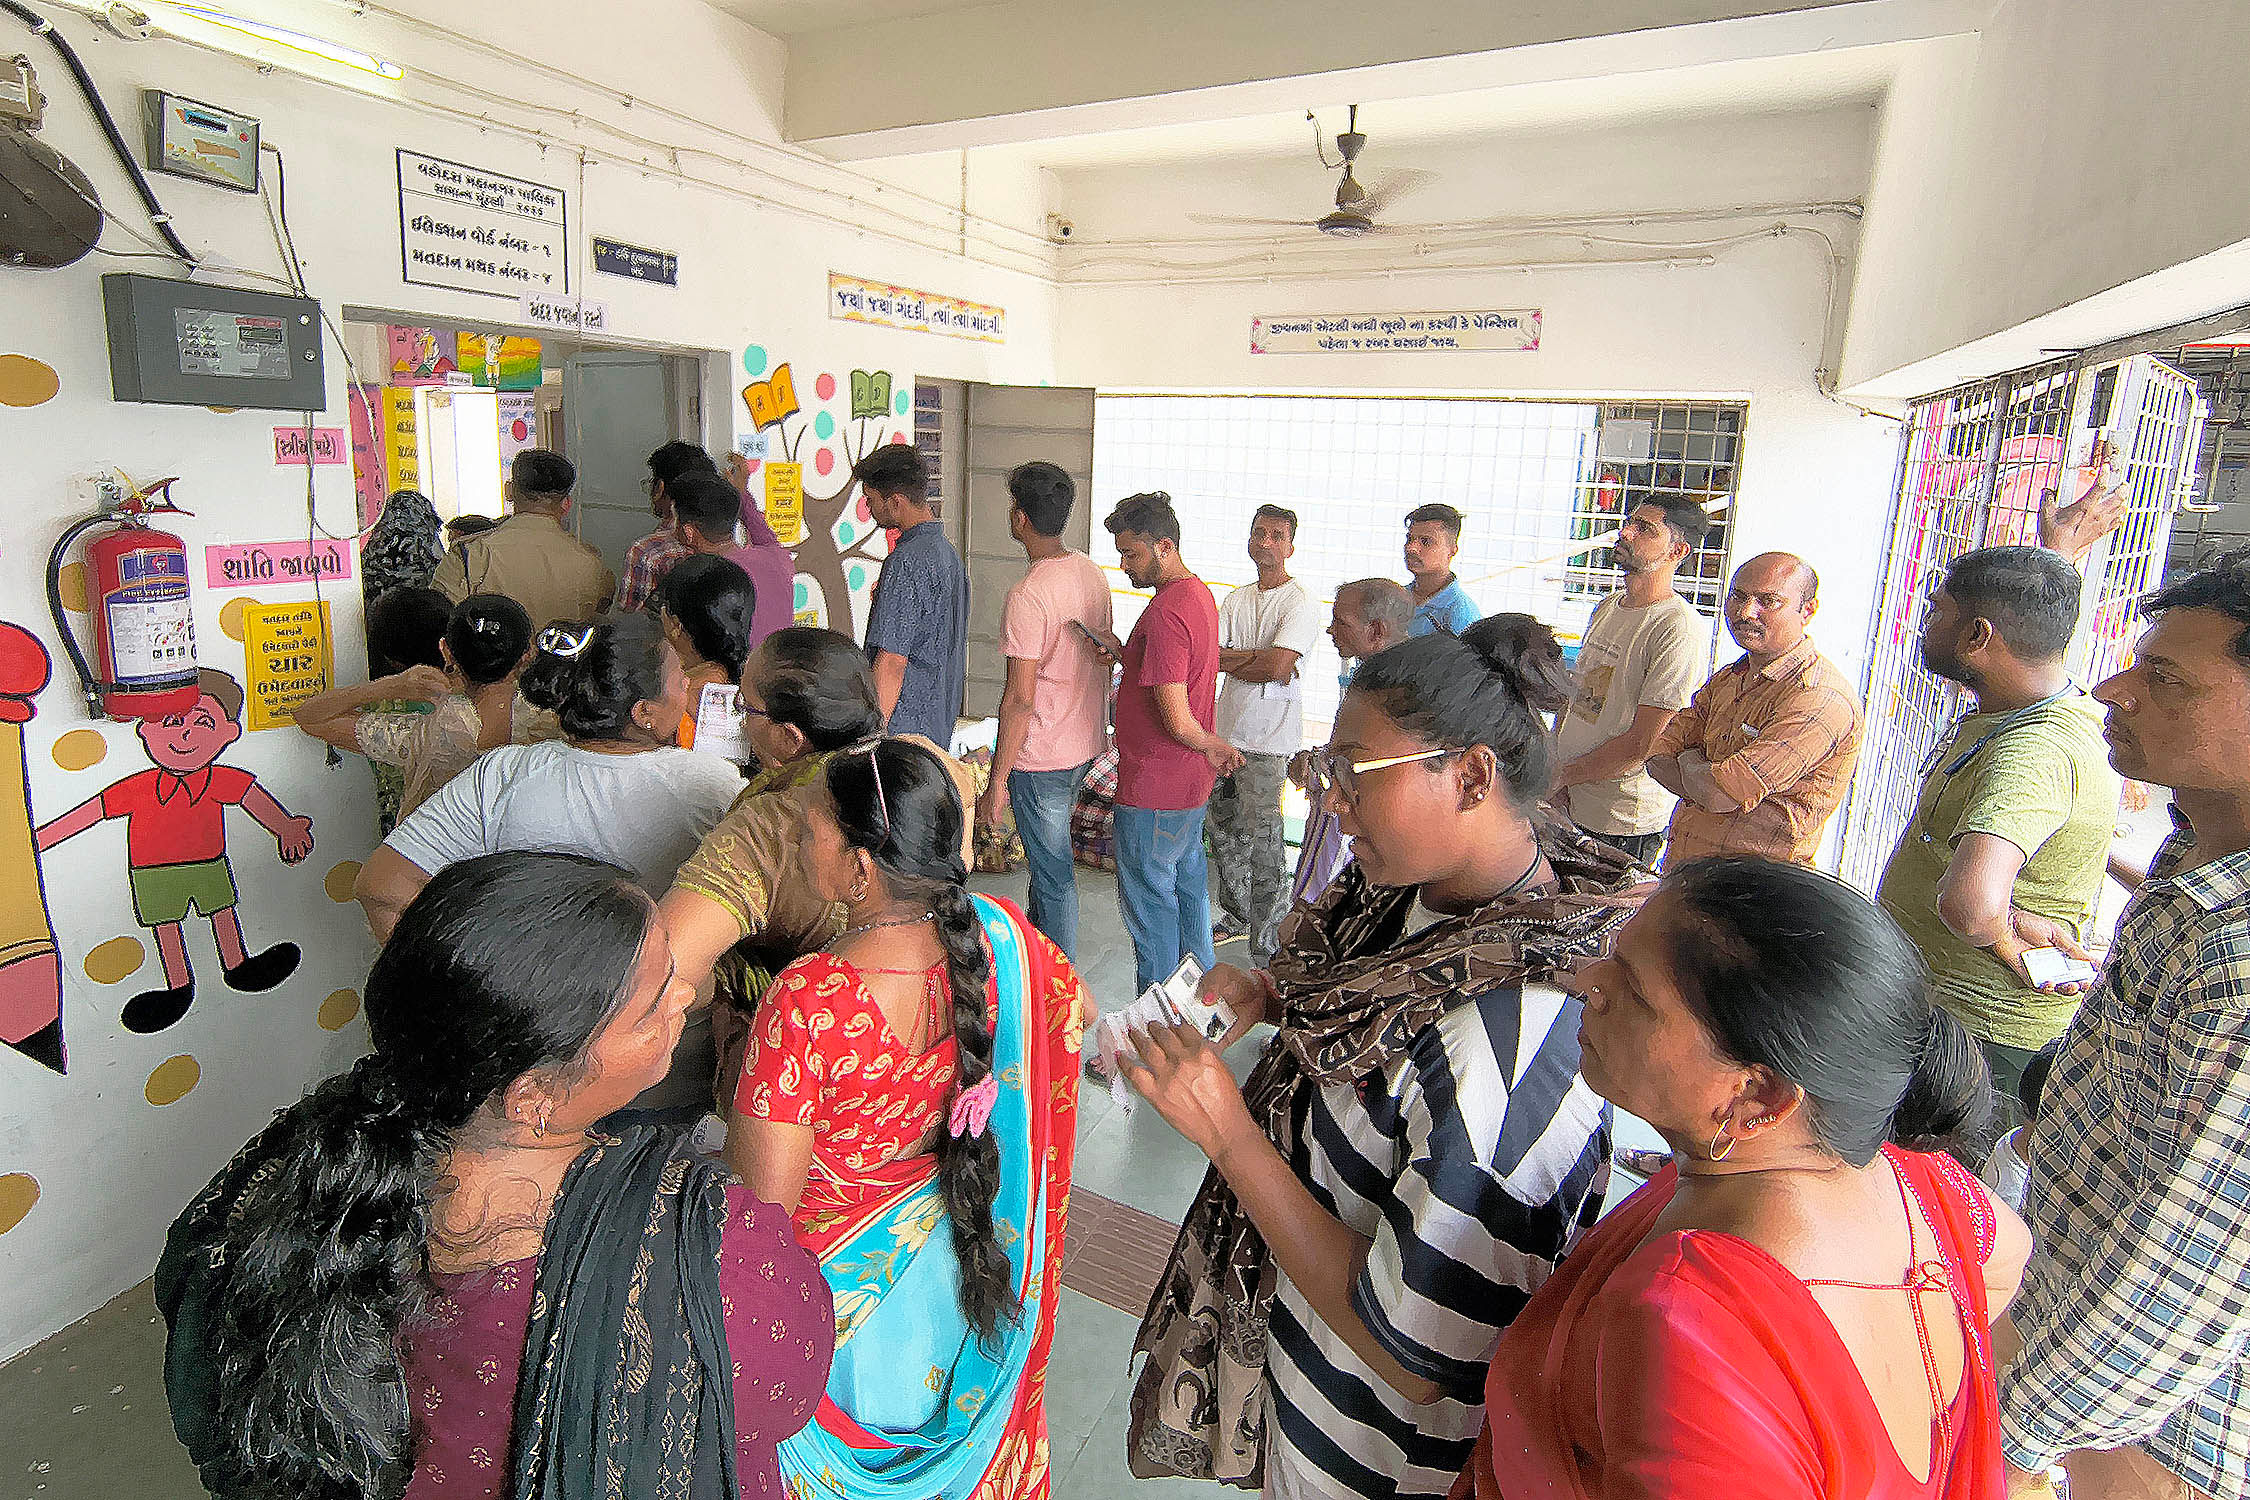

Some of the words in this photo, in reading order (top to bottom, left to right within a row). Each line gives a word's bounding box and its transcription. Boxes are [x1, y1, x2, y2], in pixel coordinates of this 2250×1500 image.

[417, 162, 462, 185] વડોદરા
[465, 174, 515, 198] મહાનગર
[518, 188, 556, 208] પાલિકા
[470, 225, 497, 247] વોર્ડ
[498, 232, 530, 254] નંબર
[412, 249, 462, 270] મતદાન
[465, 257, 497, 276] મથક
[499, 260, 531, 281] નંબર
[1315, 317, 1350, 332] એટલી
[222, 548, 275, 581] શાંતિ
[280, 544, 342, 577] જાળવો
[268, 655, 314, 673] ચાર
